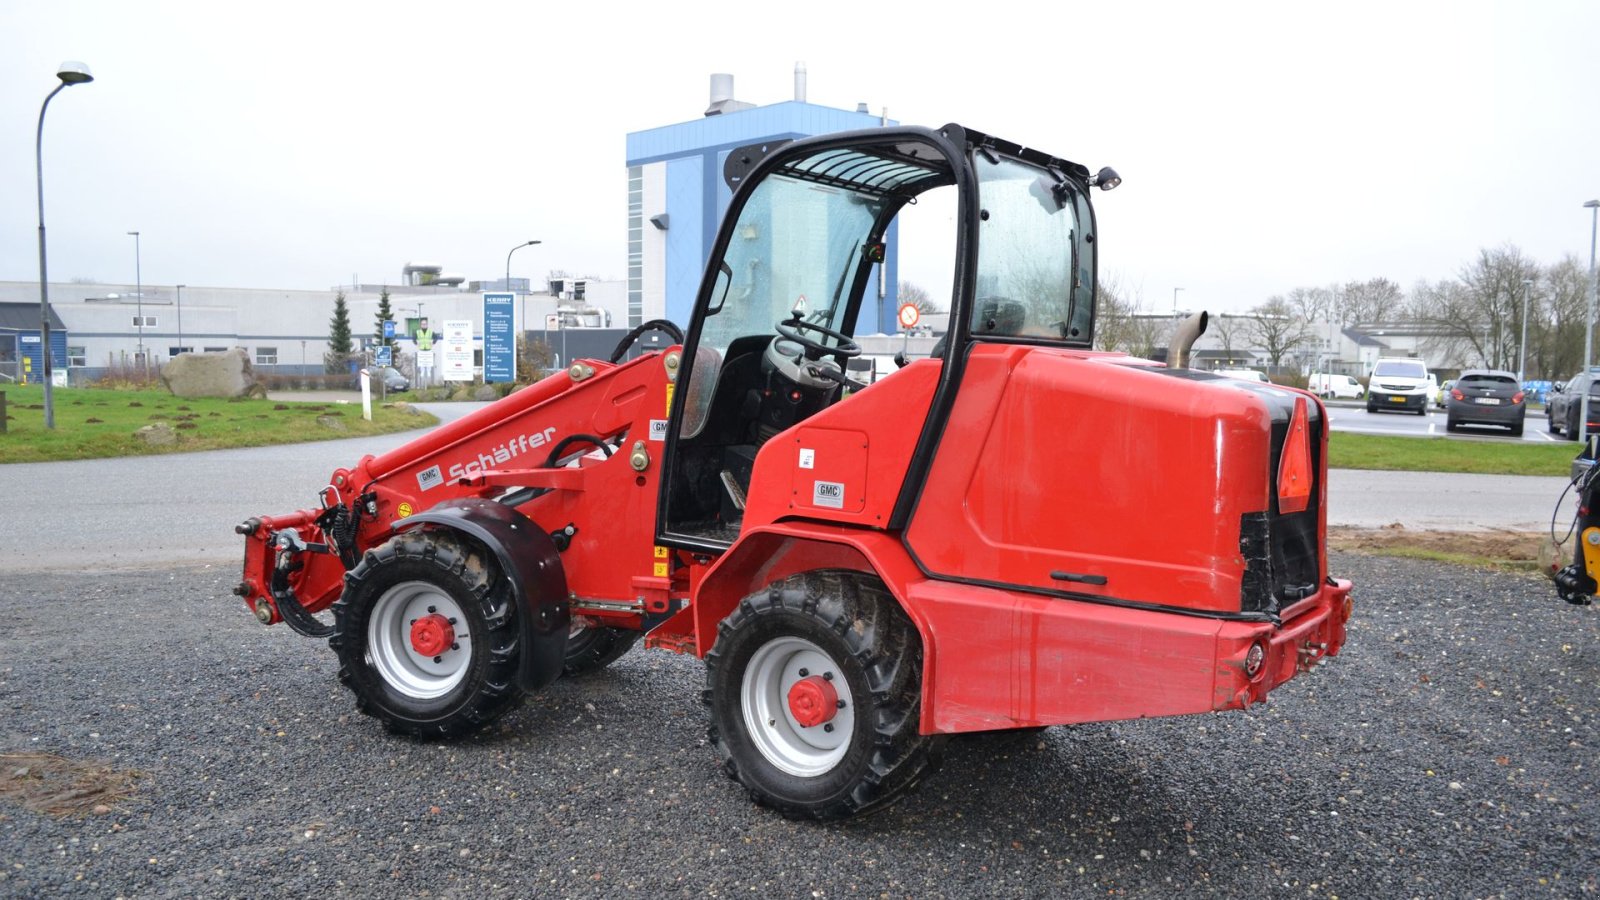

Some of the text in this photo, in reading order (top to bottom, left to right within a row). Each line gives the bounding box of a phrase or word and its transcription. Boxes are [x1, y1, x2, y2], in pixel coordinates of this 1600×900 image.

[377, 347, 383, 355] P
[655, 423, 667, 431] GM
[449, 426, 557, 478] Schäffer
[421, 469, 437, 481] GMC
[820, 485, 838, 496] GMC
